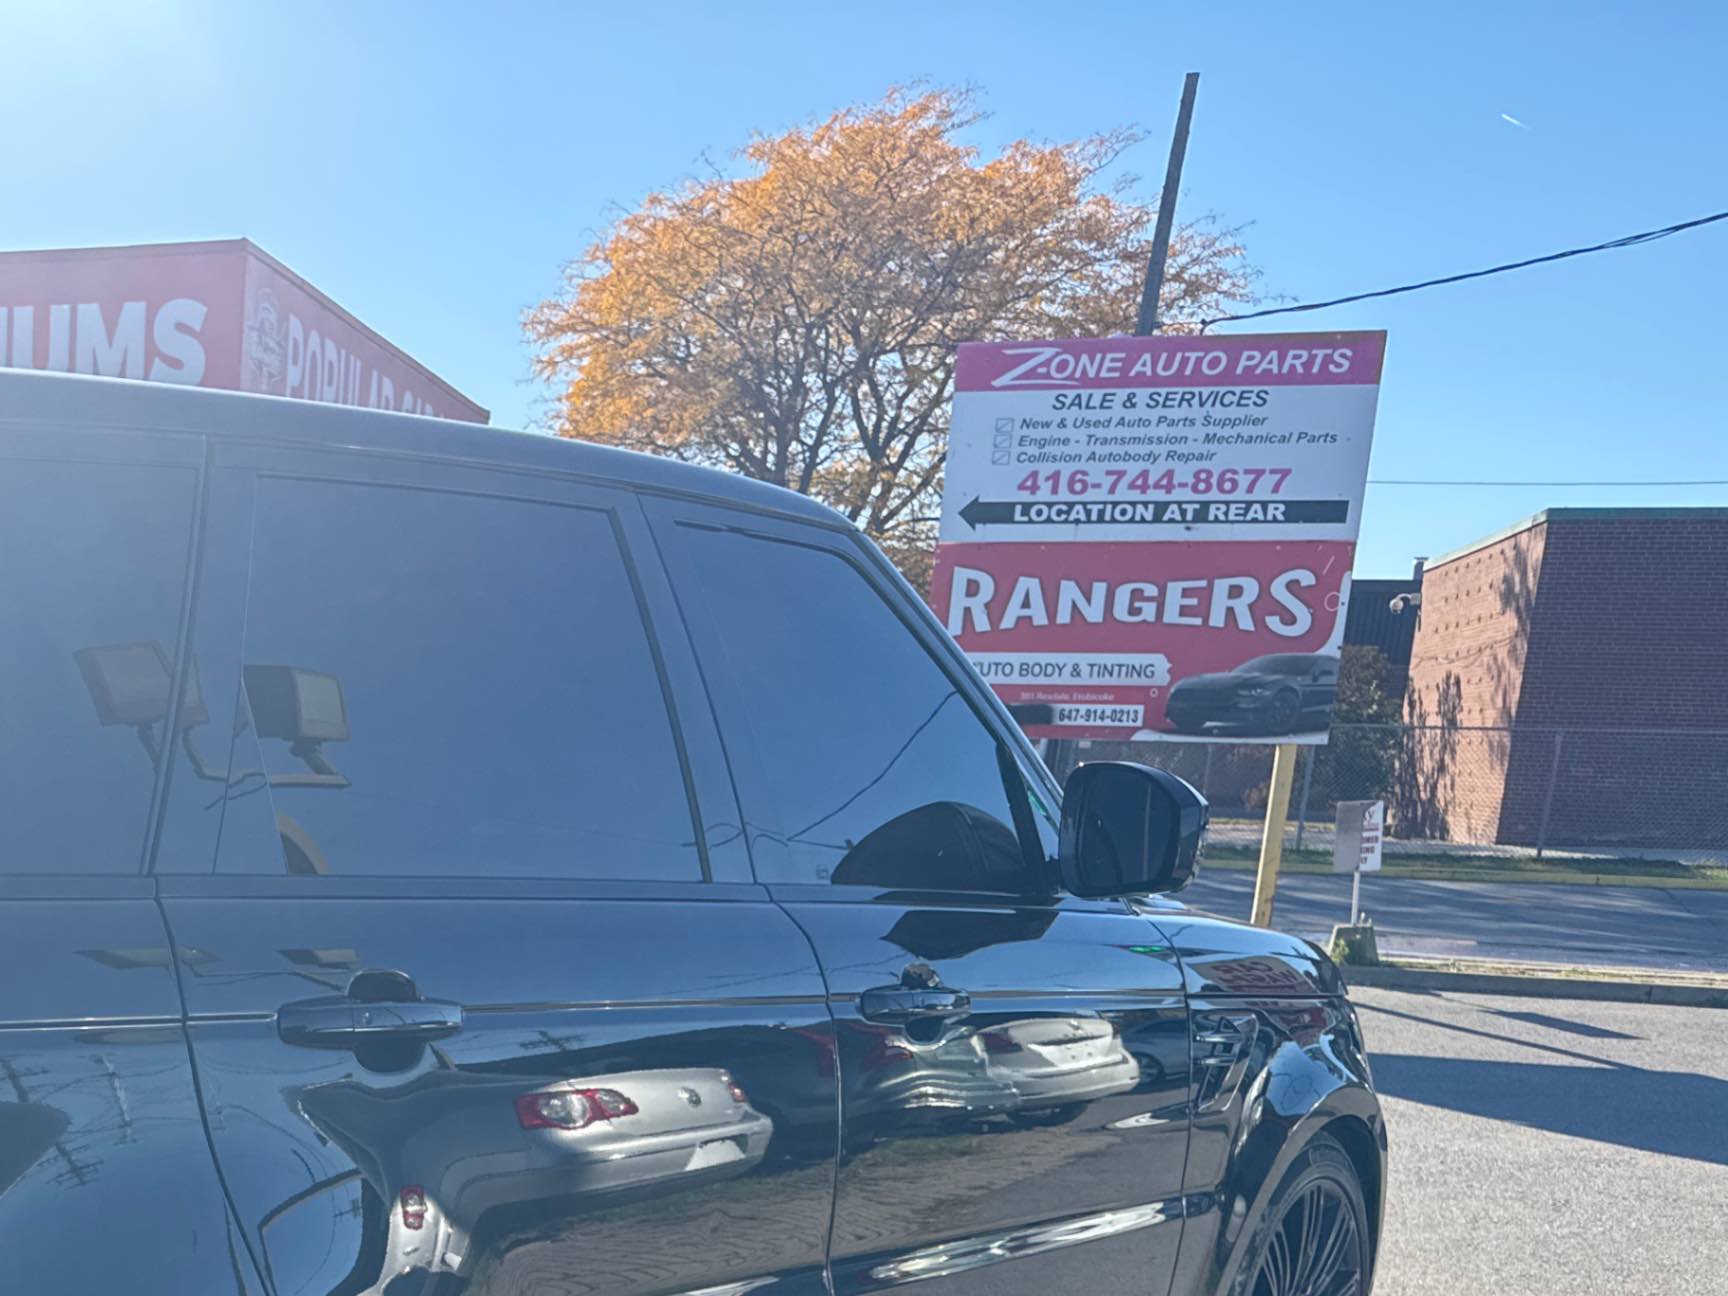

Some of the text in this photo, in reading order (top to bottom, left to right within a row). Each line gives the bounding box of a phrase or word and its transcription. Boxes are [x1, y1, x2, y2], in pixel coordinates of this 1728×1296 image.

[1129, 350, 1228, 377] AUTO
[1235, 347, 1353, 376] PARTS
[1051, 389, 1270, 411] SALE & SERVICES
[1019, 413, 1269, 430] New & Used Auto Parts Supplier
[1017, 434, 1071, 449] Engine
[1085, 433, 1189, 447] Transmission
[1202, 431, 1293, 445] Mechanical
[1295, 431, 1338, 444] Parts
[1016, 449, 1217, 465] Collision Autobody Repair
[1017, 467, 1293, 496] 416-744-8677
[1013, 502, 1287, 522] LOCATION AT REAR
[947, 565, 1317, 638] RANGERS
[1018, 661, 1068, 678] BODY
[1071, 662, 1083, 678] &
[1086, 662, 1156, 679] TINTING
[1057, 707, 1140, 724] 647-914-0213
